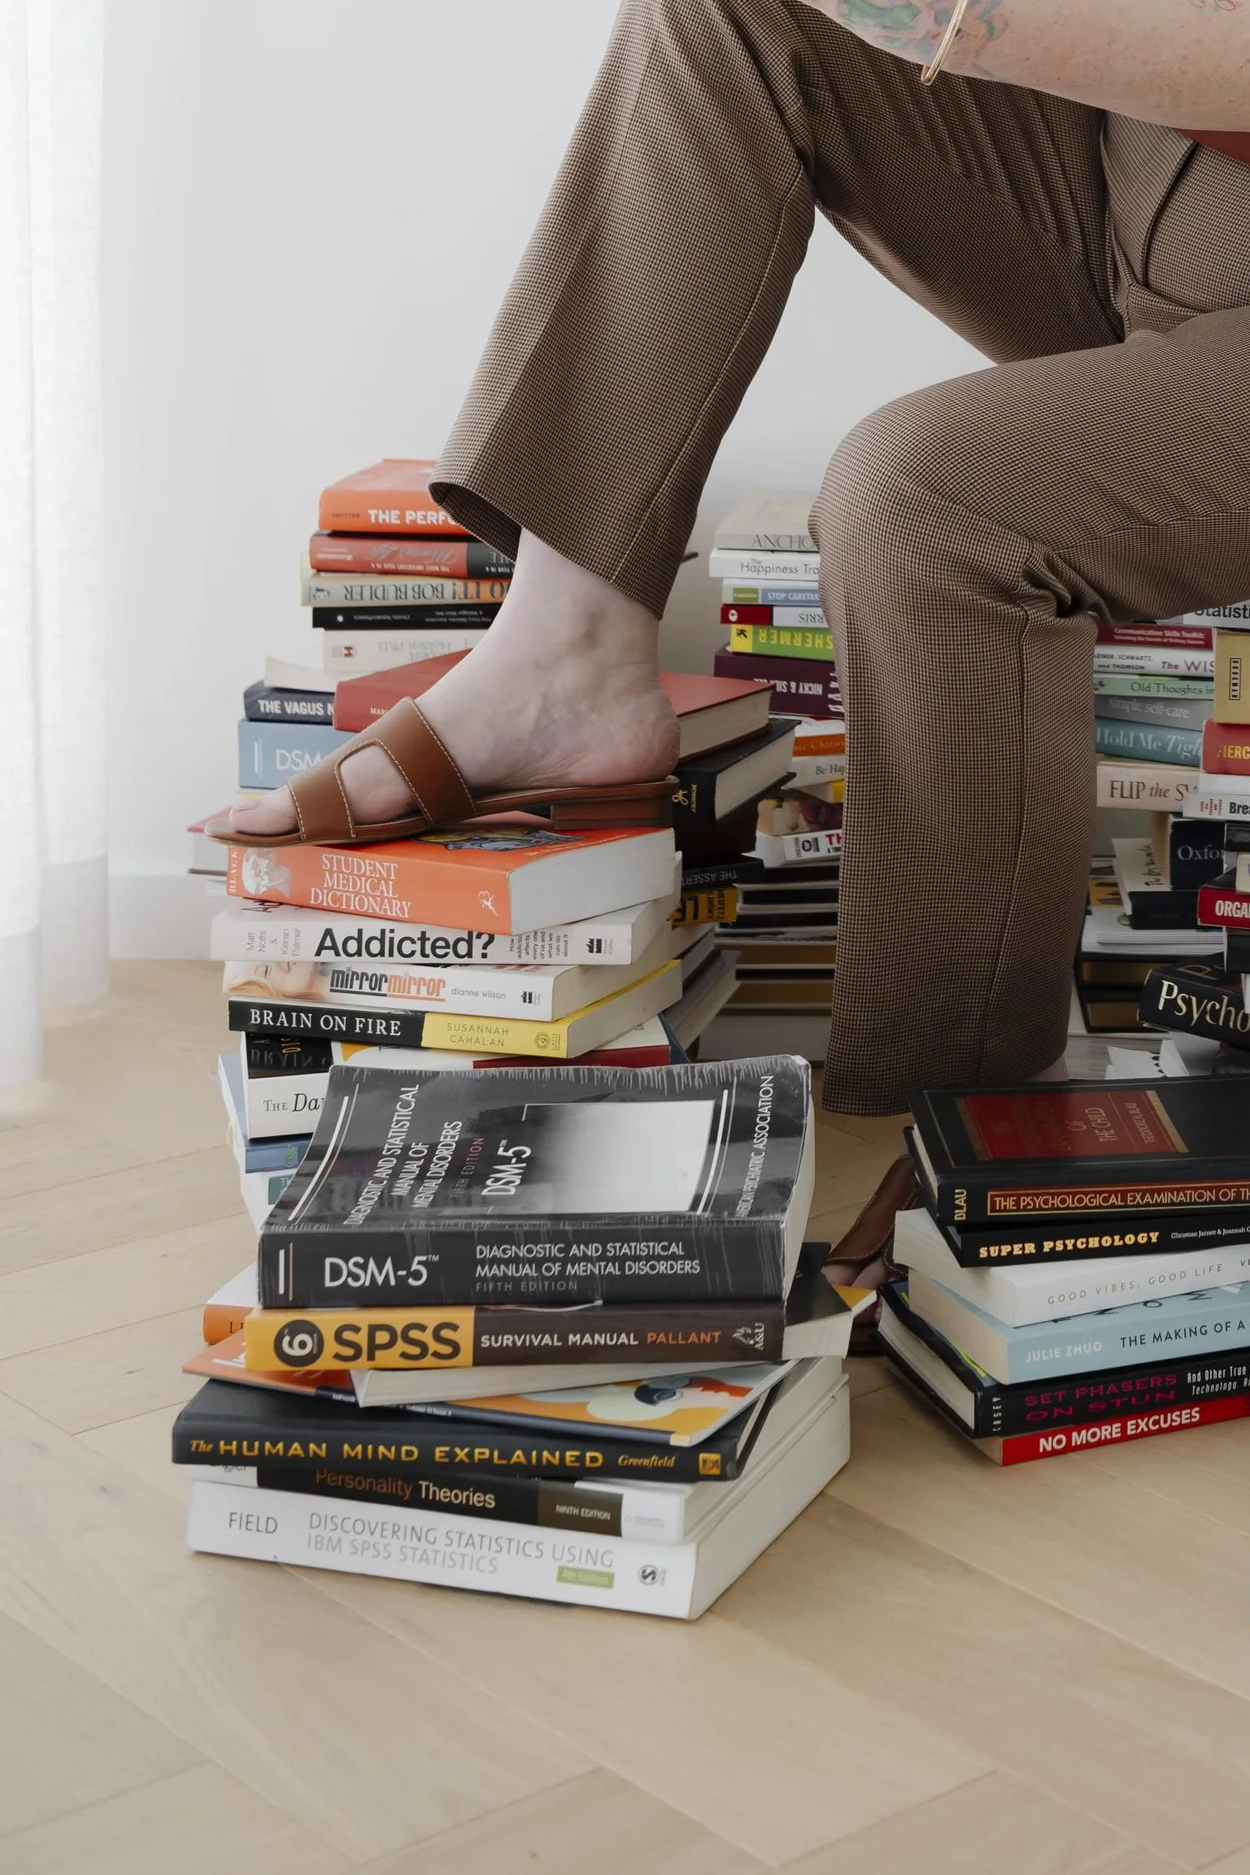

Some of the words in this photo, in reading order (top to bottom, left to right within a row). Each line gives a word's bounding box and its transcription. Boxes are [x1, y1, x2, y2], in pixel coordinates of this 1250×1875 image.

[1130, 681, 1151, 693] Old
[1153, 682, 1204, 696] Thoughts
[258, 699, 281, 713] THE
[284, 701, 324, 716] VAGUS
[1108, 697, 1143, 714] simple
[1145, 701, 1190, 720] self-care
[1110, 779, 1146, 799] FLIP
[1149, 782, 1170, 798] the
[321, 854, 399, 880] STUDENT
[323, 871, 400, 900] MEDICAL
[310, 888, 413, 920] DICTIONARY
[314, 927, 496, 960] Addicted?
[451, 987, 479, 998] dianne
[480, 988, 506, 1001] wilson
[249, 1008, 313, 1029] BRAIN
[319, 1013, 347, 1032] ON
[355, 1018, 402, 1037] FIRE
[447, 1022, 509, 1036] SUSANNAH
[449, 1034, 505, 1048] CAHALAN
[954, 1188, 967, 1221] BLAU
[993, 1195, 1017, 1211] THE
[1020, 1192, 1125, 1210] PSYCHOLOGICAL
[1127, 1188, 1216, 1205] EXAMINATION
[1218, 1188, 1238, 1202] OF
[475, 1243, 565, 1260] DIAGNOSTIC
[569, 1242, 603, 1258] AND
[605, 1241, 685, 1257] STATISTICAL
[475, 1262, 539, 1278] MANUAL
[541, 1261, 562, 1277] OF
[566, 1260, 621, 1276] MENTAL
[625, 1259, 701, 1275] DISORDERS
[475, 1281, 514, 1293] FIFTH
[520, 1279, 579, 1293] EDITION
[331, 1320, 462, 1364] SPSS
[480, 1331, 563, 1349] SURVIVAL
[567, 1331, 640, 1347] MANUAL
[646, 1330, 723, 1345] PALLANT
[1024, 1346, 1063, 1364] JULIE
[1065, 1340, 1104, 1357] ZHUO
[1120, 1333, 1147, 1349] THE
[1152, 1324, 1209, 1345] MAKING
[1213, 1321, 1231, 1334] OF
[1236, 1320, 1246, 1331] A
[1187, 1370, 1202, 1385] And
[1205, 1368, 1227, 1382] Other
[1230, 1364, 1247, 1377] True
[1024, 1389, 1066, 1408] SET
[1074, 1373, 1179, 1400] PHASERS
[1038, 1433, 1068, 1454] NO
[1071, 1422, 1122, 1448] MORE
[1125, 1406, 1201, 1437] EXCUSES
[189, 1438, 214, 1454] The
[218, 1438, 328, 1459] HUMAN
[343, 1442, 421, 1462] MIND
[433, 1445, 605, 1469] EXPLAINED
[616, 1453, 677, 1470] Greenfield
[314, 1467, 414, 1501] Personality
[417, 1479, 496, 1510] Theories
[228, 1511, 279, 1535] FIELD
[309, 1511, 438, 1546] DISCOVERING
[444, 1529, 545, 1560] STATISTICS
[551, 1542, 615, 1570] USING
[306, 1532, 344, 1555] IBM
[349, 1537, 393, 1561] SPSS
[398, 1545, 499, 1575] STATISTICS
